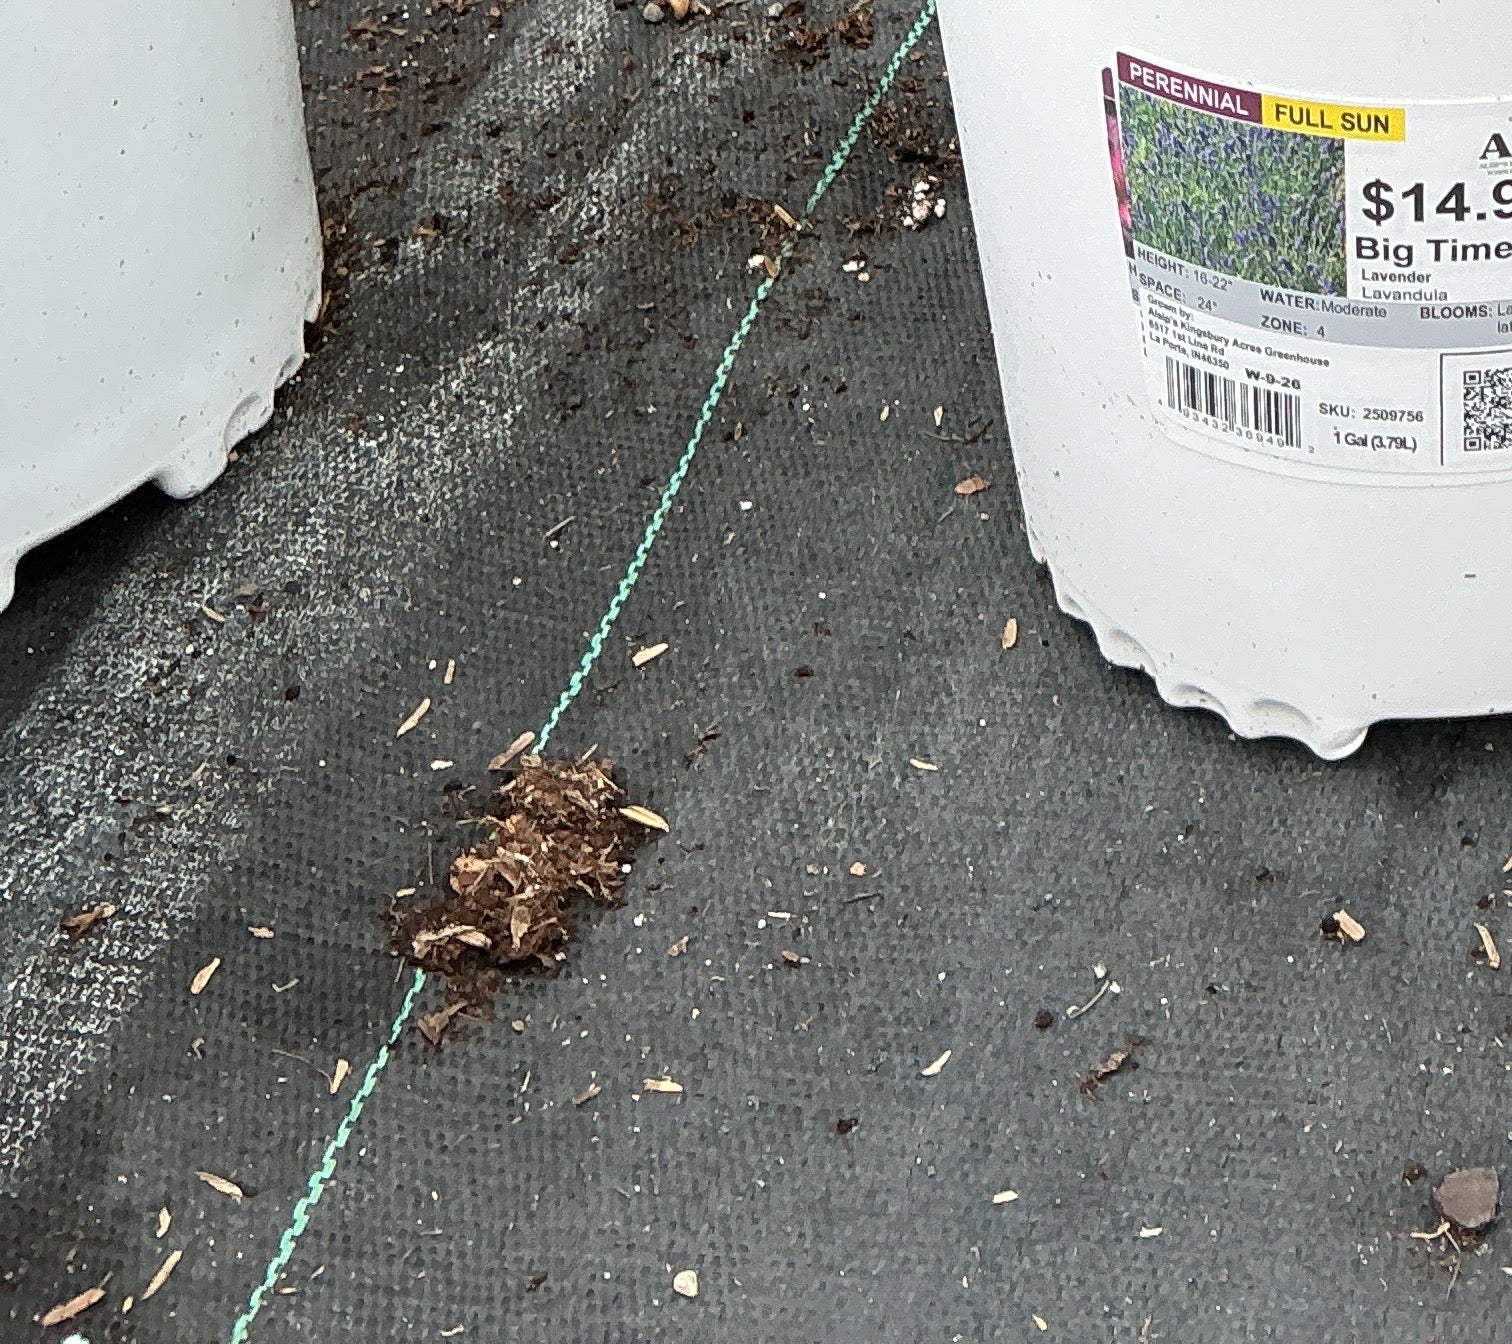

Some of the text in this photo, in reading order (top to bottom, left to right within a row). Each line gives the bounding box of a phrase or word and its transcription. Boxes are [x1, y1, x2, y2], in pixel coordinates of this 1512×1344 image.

[1129, 62, 1389, 134] PERENNIAL FULL SUN
[1137, 246, 1189, 279] HEIGHT:
[1355, 236, 1414, 268] Big
[1361, 268, 1431, 284] Lavender
[1139, 273, 1186, 305] SPACE:
[1362, 286, 1448, 302] Lavandula
[1321, 300, 1387, 318] Moderate
[1420, 305, 1493, 320] BLOOMS:
[1261, 314, 1325, 338] ZONE: 4
[1149, 331, 1161, 344] La
[1180, 320, 1229, 347] Kingsbury
[1232, 337, 1262, 354] Acres
[1264, 346, 1330, 367] Greenhouse
[1188, 336, 1208, 351] Line
[1210, 343, 1225, 356] Rd
[1319, 402, 1424, 422] SKU: 2509756
[1333, 430, 1418, 454] 1 Gal (3.79L)
